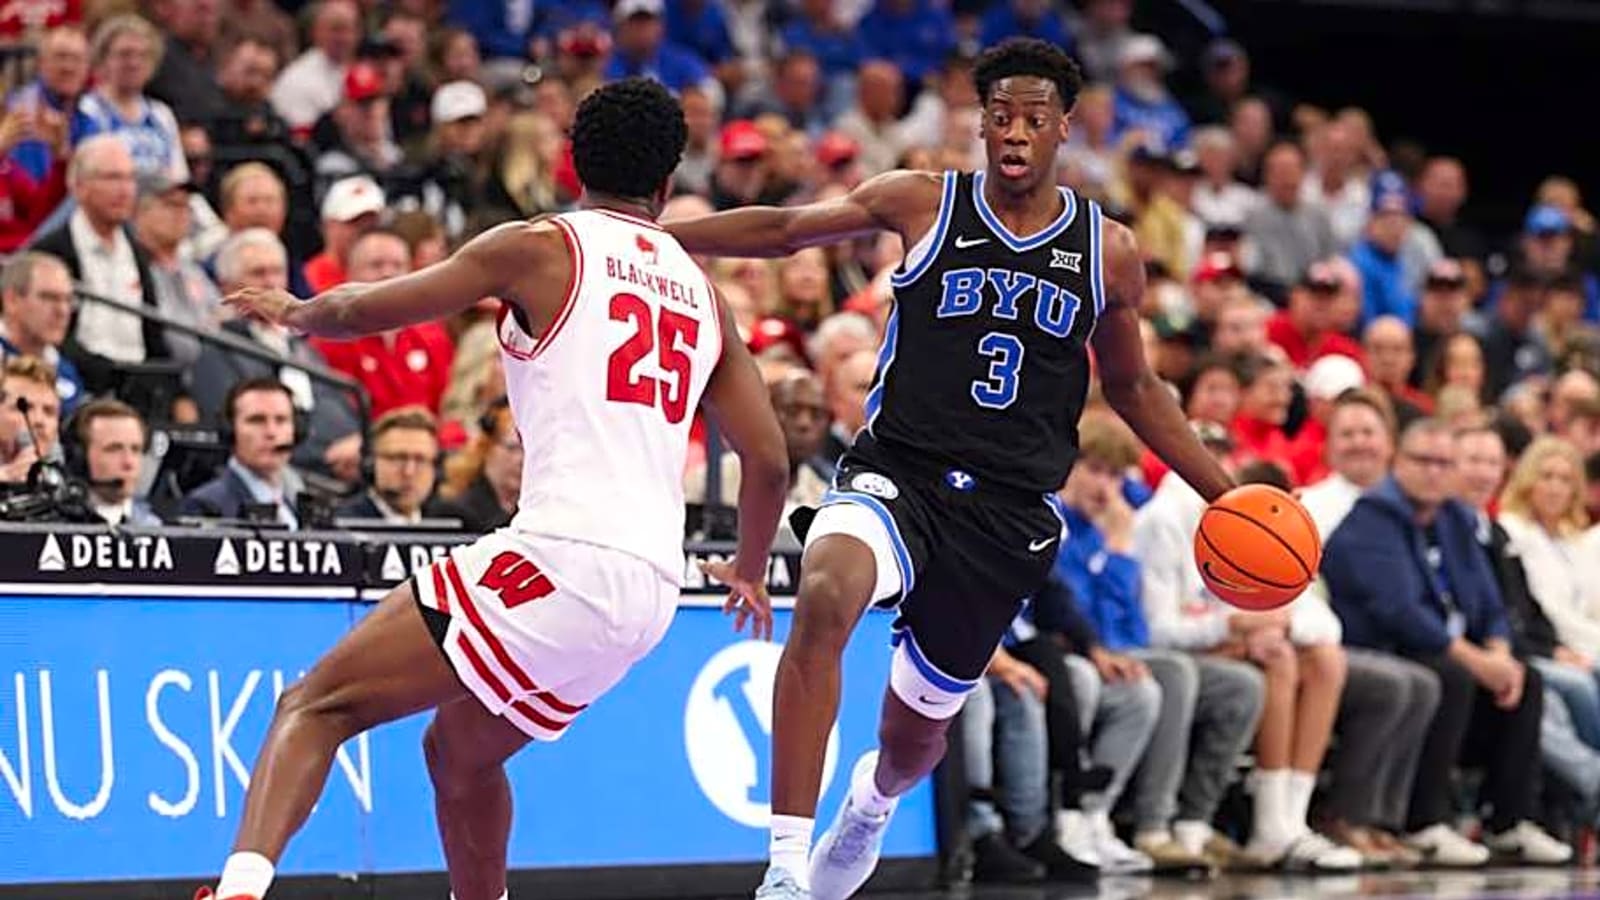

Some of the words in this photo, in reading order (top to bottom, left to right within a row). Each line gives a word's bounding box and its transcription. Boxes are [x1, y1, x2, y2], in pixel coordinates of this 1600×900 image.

[606, 256, 698, 309] BLACKWELL
[937, 267, 1081, 338] BYU
[606, 292, 700, 424] 25
[971, 332, 1025, 409] 3
[72, 535, 173, 570] DELTA
[246, 540, 342, 575] DELTA
[477, 551, 556, 609] W
[146, 669, 374, 819] SK
